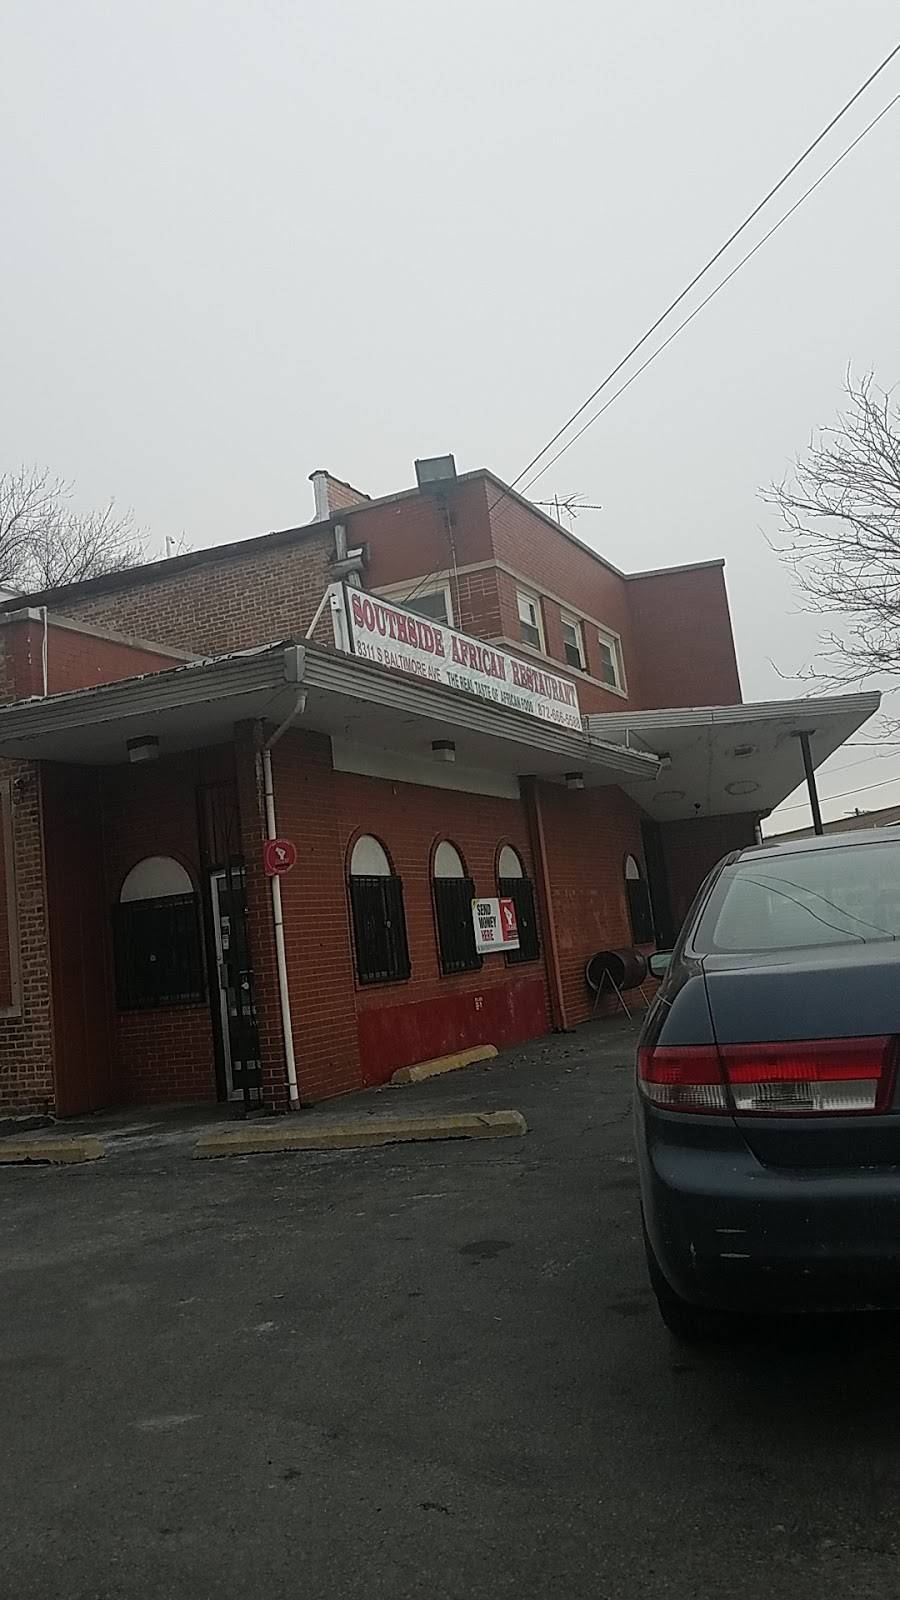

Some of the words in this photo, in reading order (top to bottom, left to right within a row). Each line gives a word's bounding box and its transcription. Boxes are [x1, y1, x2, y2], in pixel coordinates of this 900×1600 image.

[352, 594, 445, 657] SOUTHSIDE
[451, 635, 506, 681] AFRICAN
[511, 660, 577, 707] RESTAURANT
[357, 640, 376, 660] 8311
[377, 648, 383, 661] S
[384, 650, 426, 677] BALTIMORE
[427, 666, 441, 682] AVE
[447, 671, 458, 688] THE
[459, 677, 474, 694] REAL
[474, 681, 492, 699] TASTE
[492, 686, 499, 700] OF
[500, 689, 520, 707] AFRICAN
[521, 698, 534, 712] FOOD
[477, 904, 491, 916] SEND
[479, 916, 496, 928] MONEY
[481, 930, 494, 941] HERE
